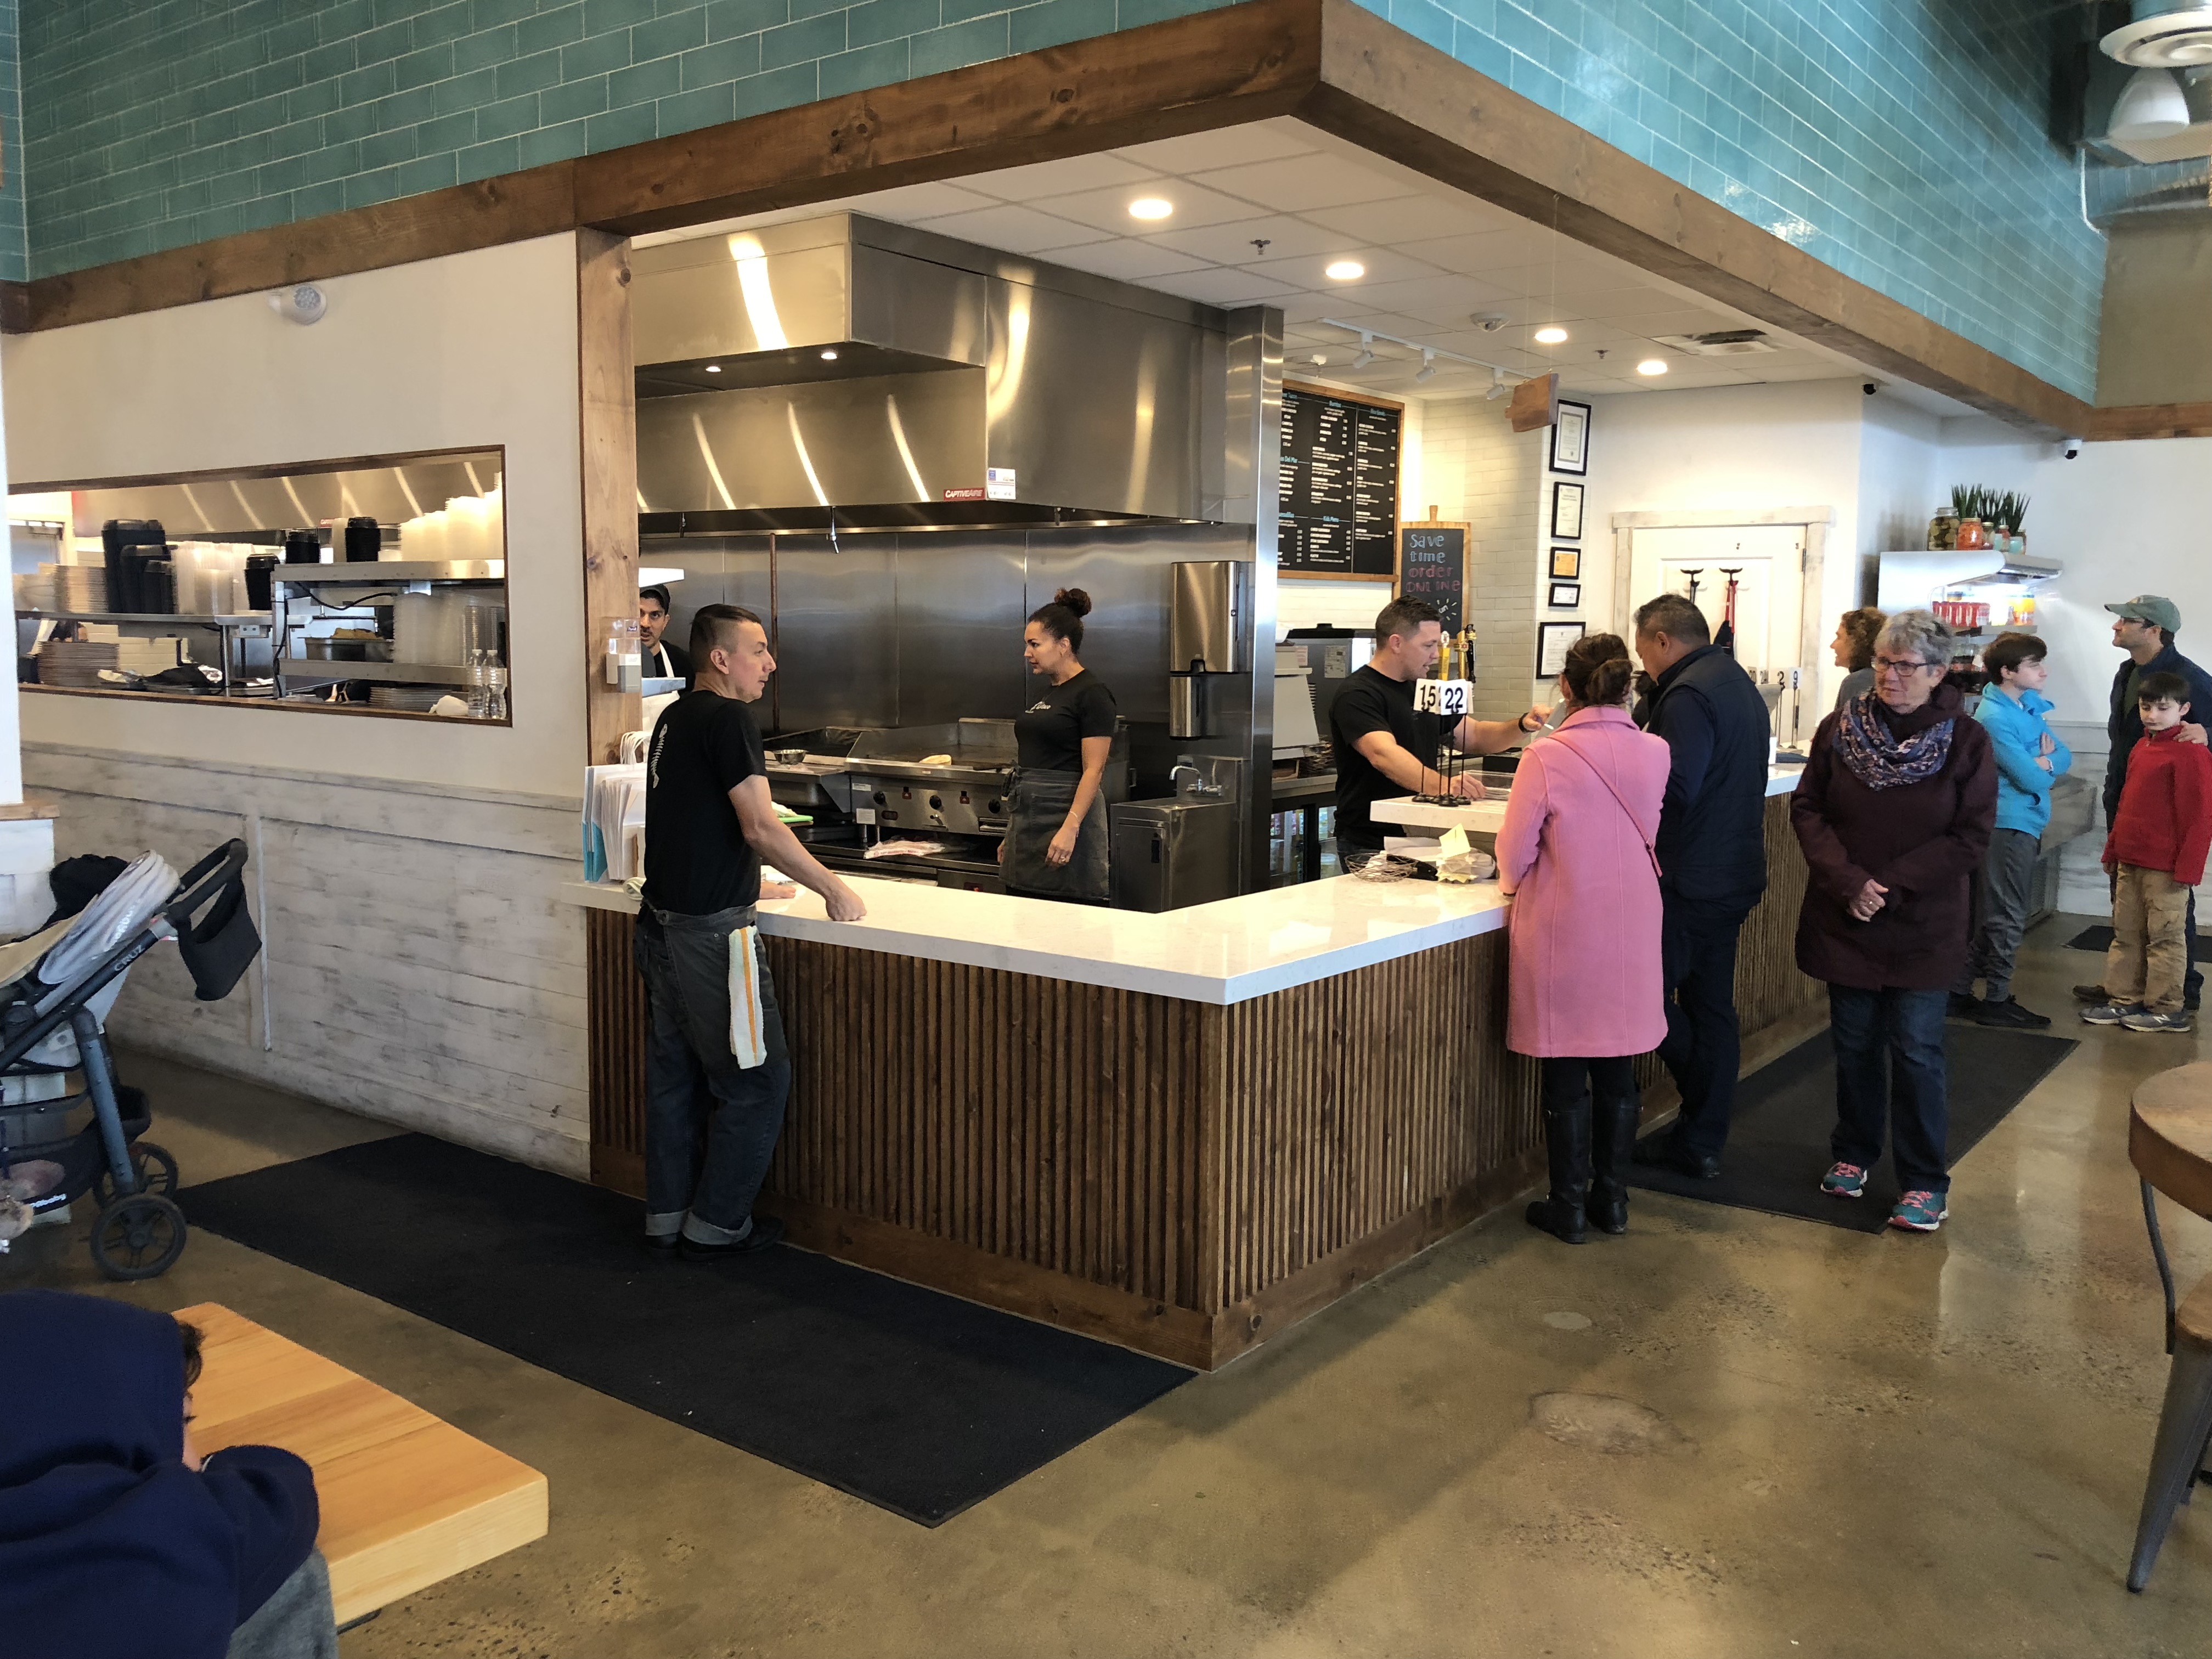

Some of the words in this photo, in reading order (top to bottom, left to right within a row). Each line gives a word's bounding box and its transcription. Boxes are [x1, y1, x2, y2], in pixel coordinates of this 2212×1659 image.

[1409, 534, 1444, 548] Save
[1409, 551, 1446, 563] time
[1408, 565, 1454, 578] order
[1420, 684, 1436, 707] 15
[1444, 687, 1464, 709] 22
[114, 944, 146, 971] CRUZ
